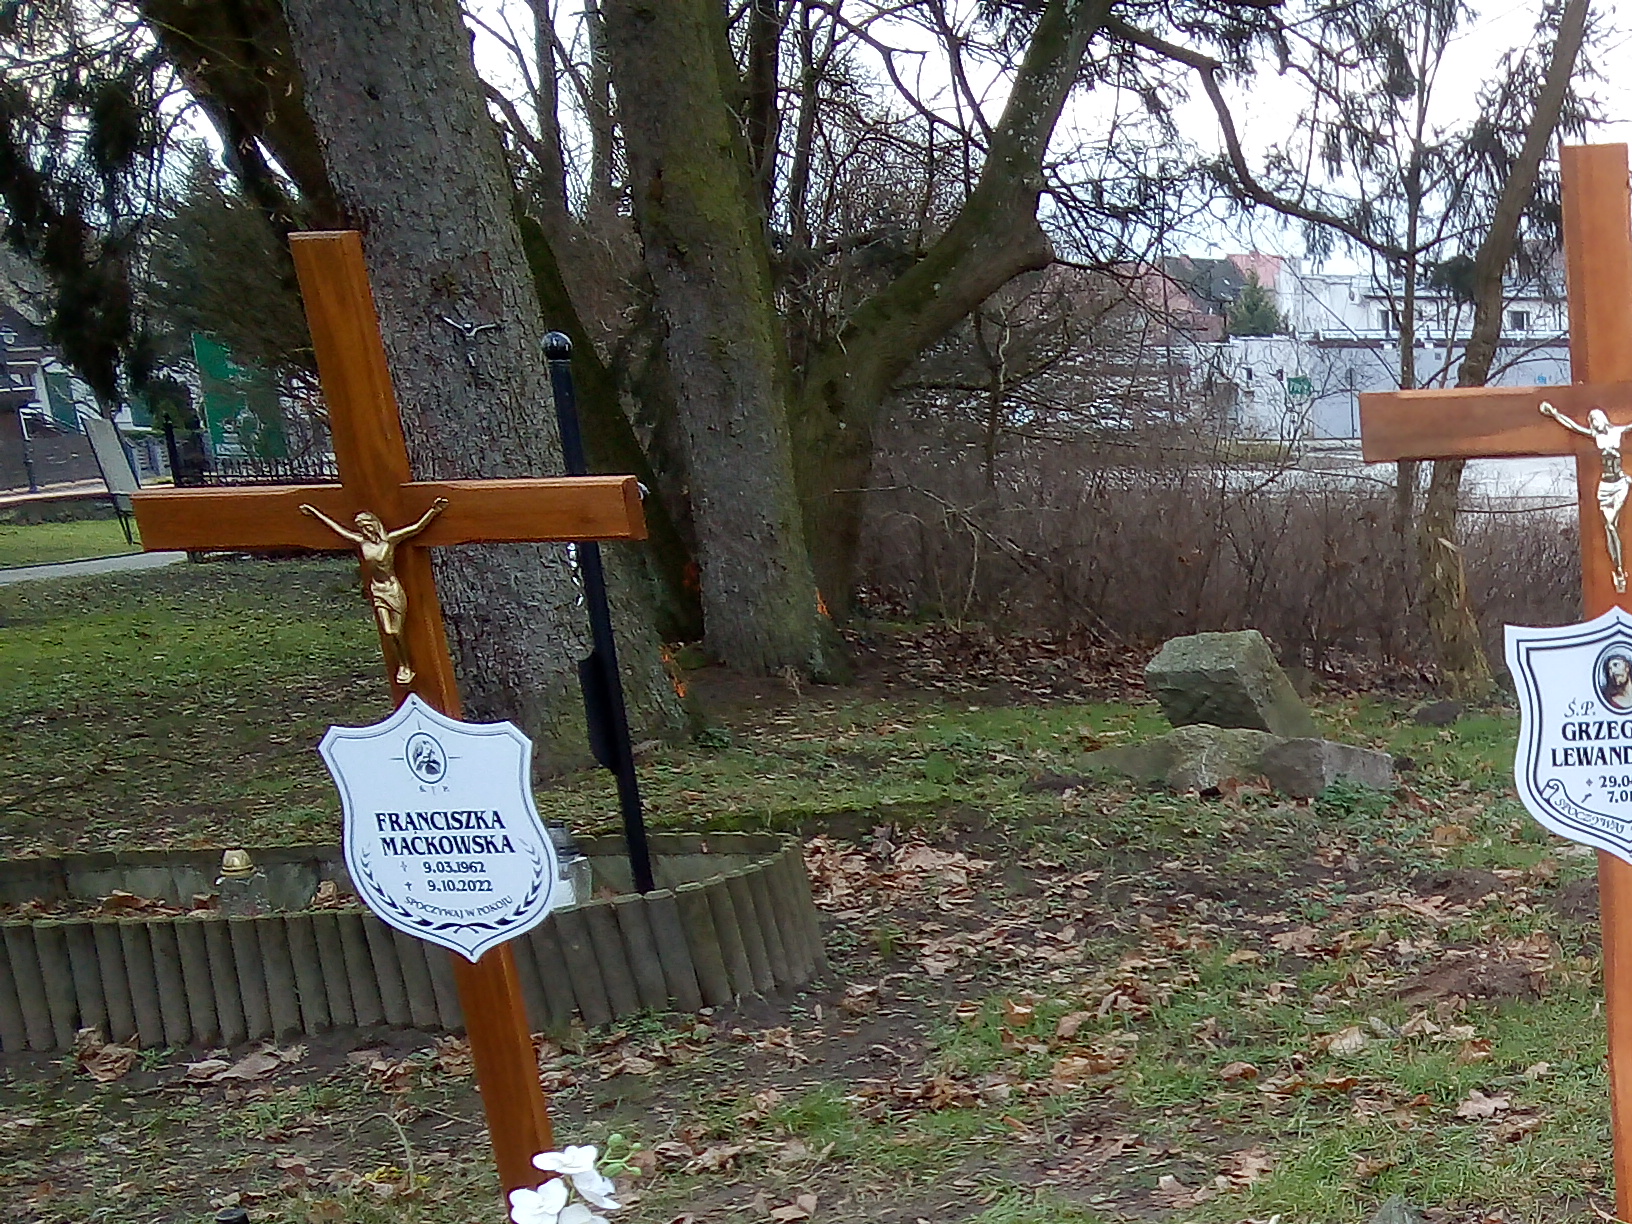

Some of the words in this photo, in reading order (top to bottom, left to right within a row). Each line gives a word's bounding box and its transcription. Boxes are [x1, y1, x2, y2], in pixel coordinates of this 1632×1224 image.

[374, 811, 506, 832] FRANCISZKA
[422, 861, 487, 874] 9.03.1962
[428, 880, 493, 892] 9.10.2022
